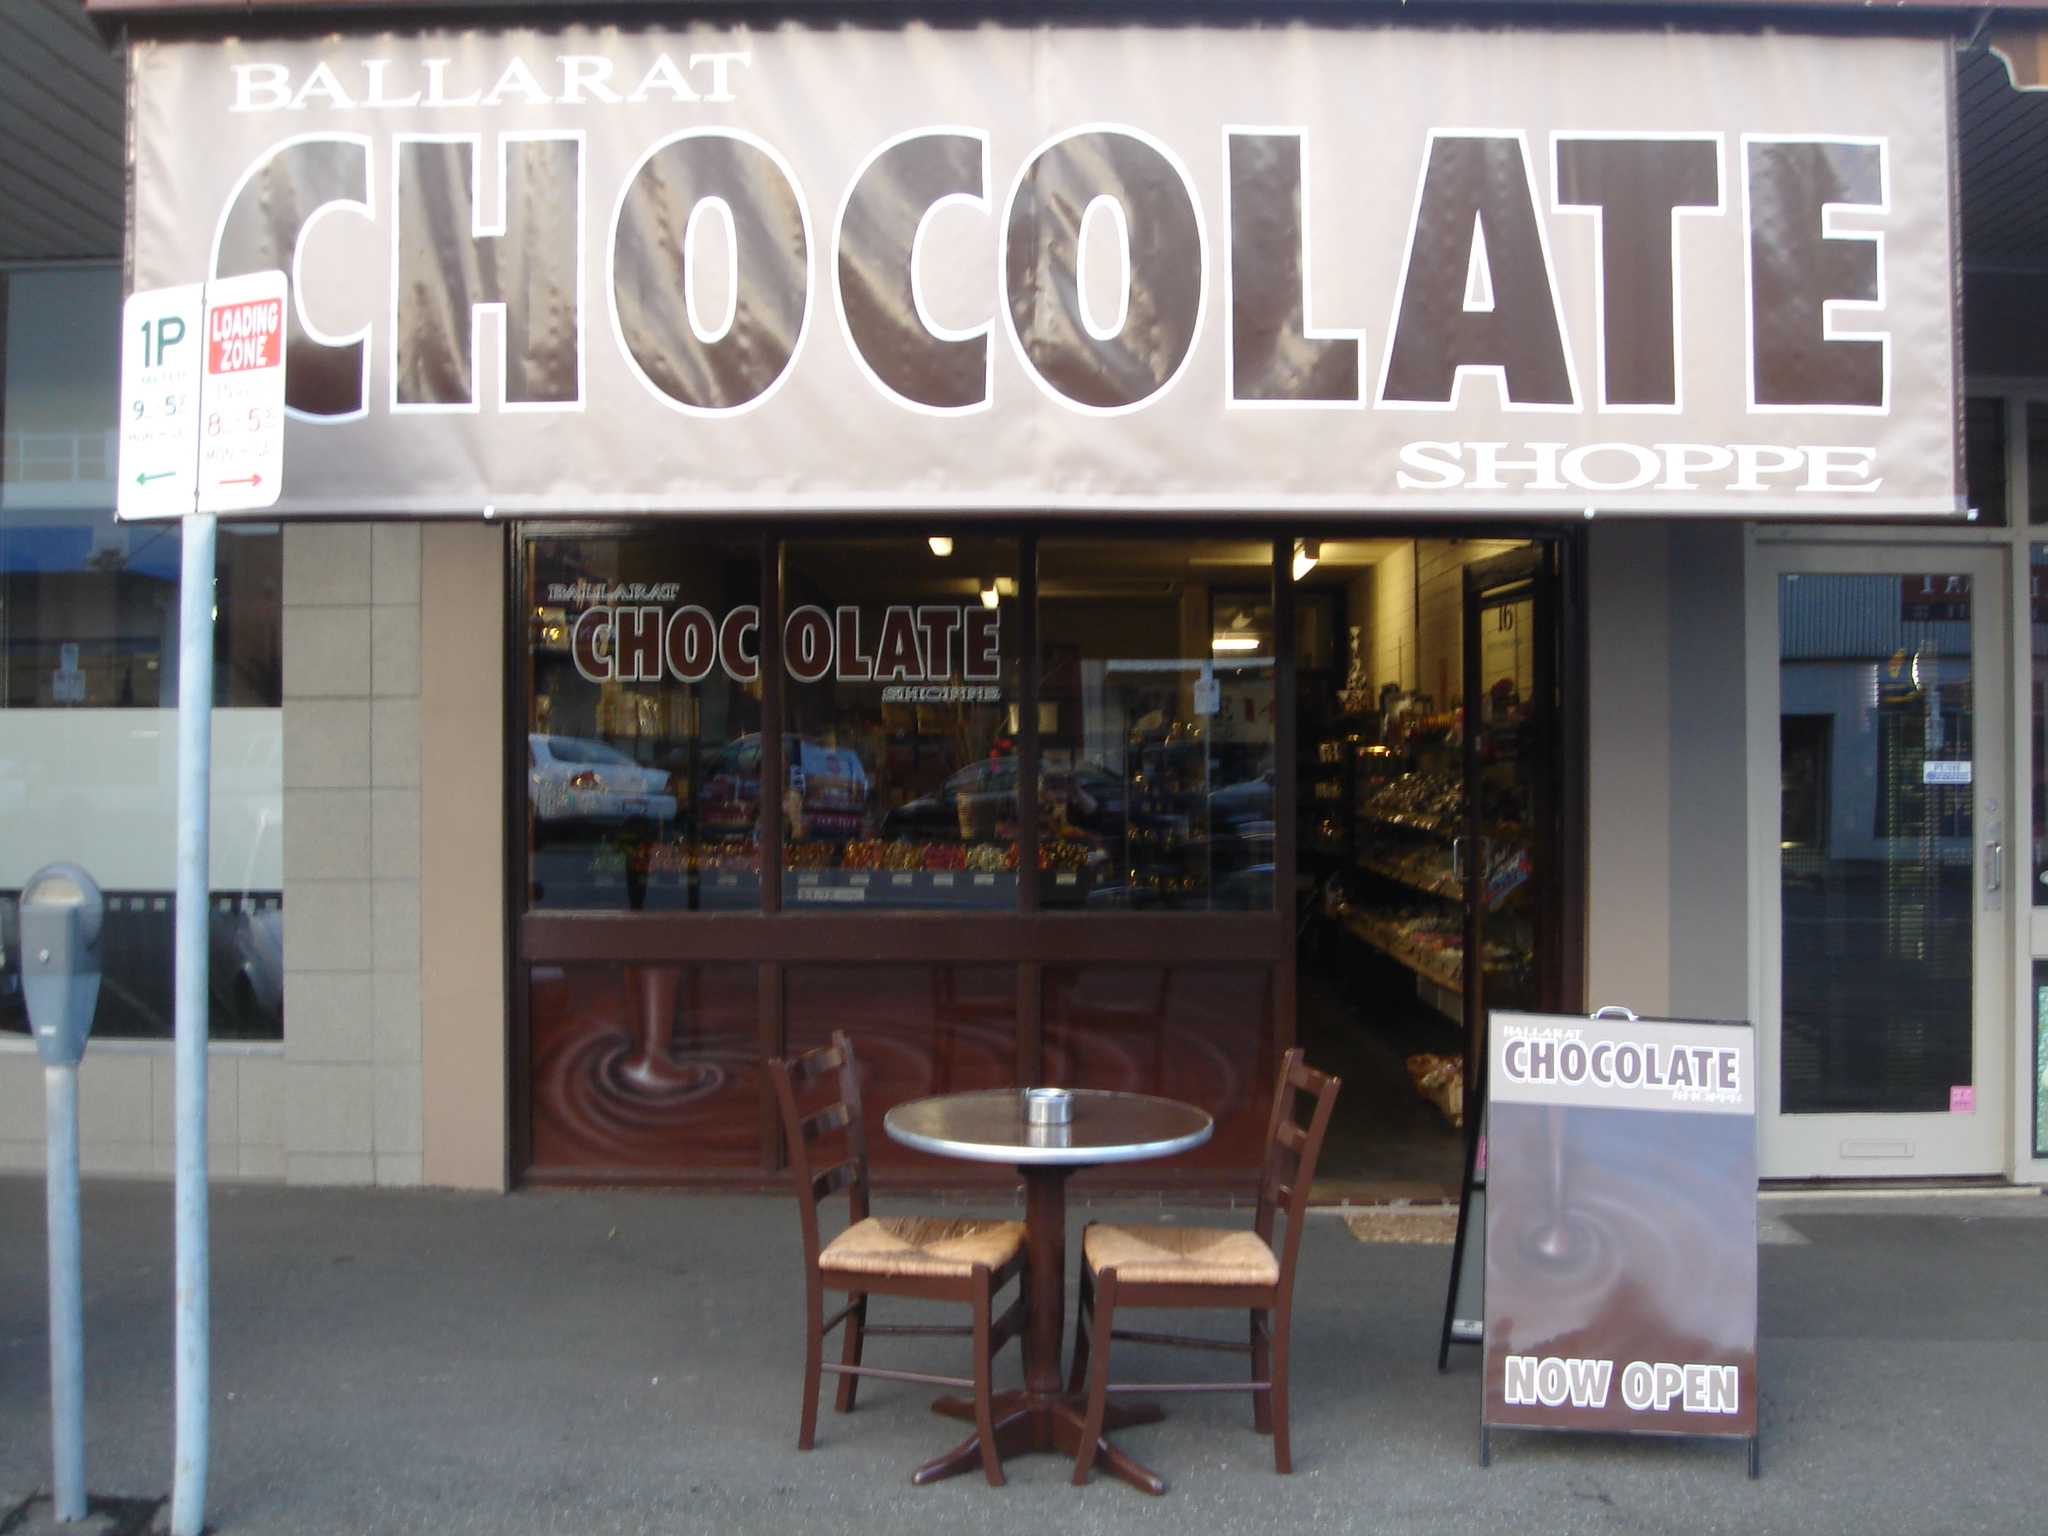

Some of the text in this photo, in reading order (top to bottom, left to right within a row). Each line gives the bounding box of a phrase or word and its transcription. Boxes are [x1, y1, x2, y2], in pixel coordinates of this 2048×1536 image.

[229, 51, 753, 113] BALLARAT
[209, 121, 1891, 424] CHOCOLATE
[141, 315, 186, 368] 1P
[212, 301, 279, 342] LOADING
[220, 335, 269, 372] ZONE
[1396, 440, 1884, 494] SHOPPE
[548, 583, 680, 601] BALLARAT
[1503, 1025, 1583, 1039] BALLARAT
[1502, 1037, 1741, 1093] CHOCOLATE
[1504, 1355, 1739, 1414] NOW OPEN
